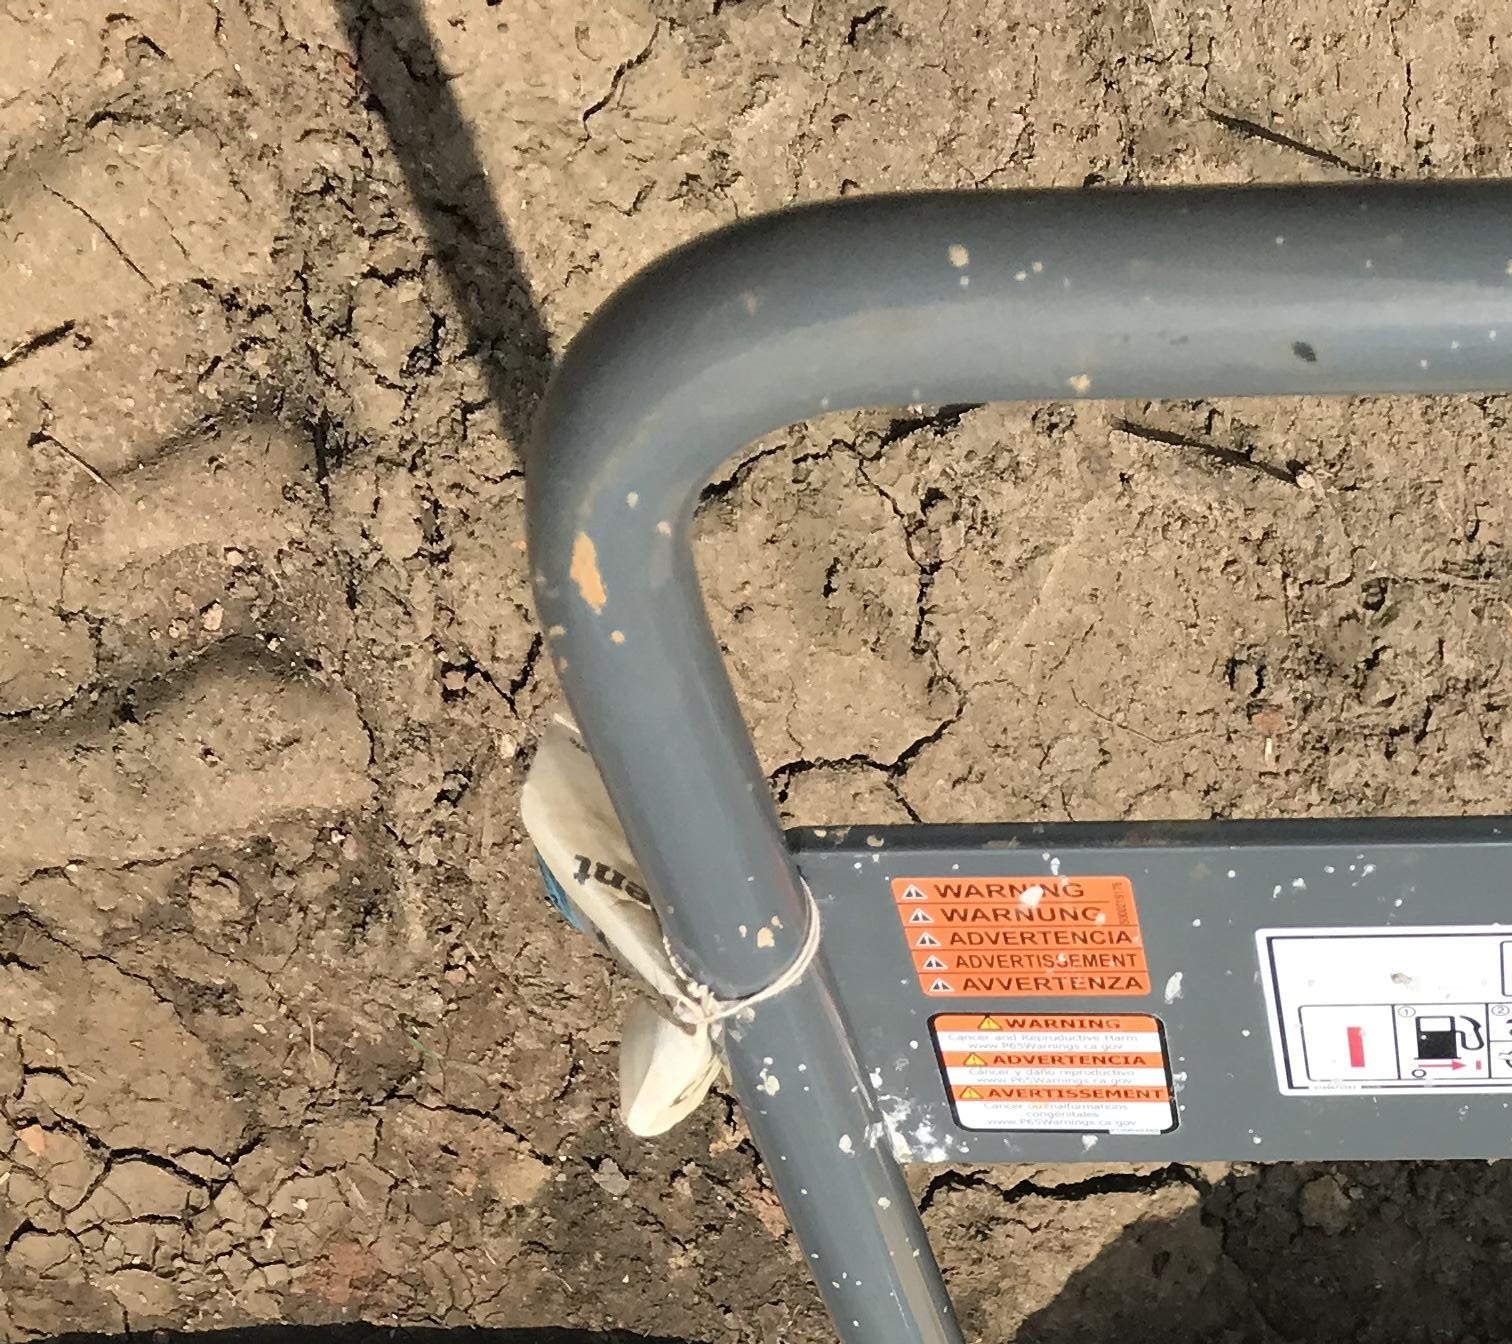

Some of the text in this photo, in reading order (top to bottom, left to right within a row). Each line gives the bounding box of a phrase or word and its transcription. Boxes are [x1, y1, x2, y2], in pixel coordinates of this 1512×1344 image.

[933, 884, 1085, 899] WARNNG
[940, 907, 1105, 922] WARNUNG
[949, 930, 1133, 946] ADVERTENCIA
[955, 953, 1137, 969] ADVERTISSEMENT
[962, 976, 1143, 991] AVVERTENZA
[1005, 1019, 1121, 1029] WARNING
[948, 1033, 1138, 1042] Cancer and Reproductive Harm
[992, 1055, 1147, 1065] ADVERTENCIA
[1060, 1069, 1135, 1078] reproductivo
[988, 1088, 1164, 1099] AVERTISSEMENT
